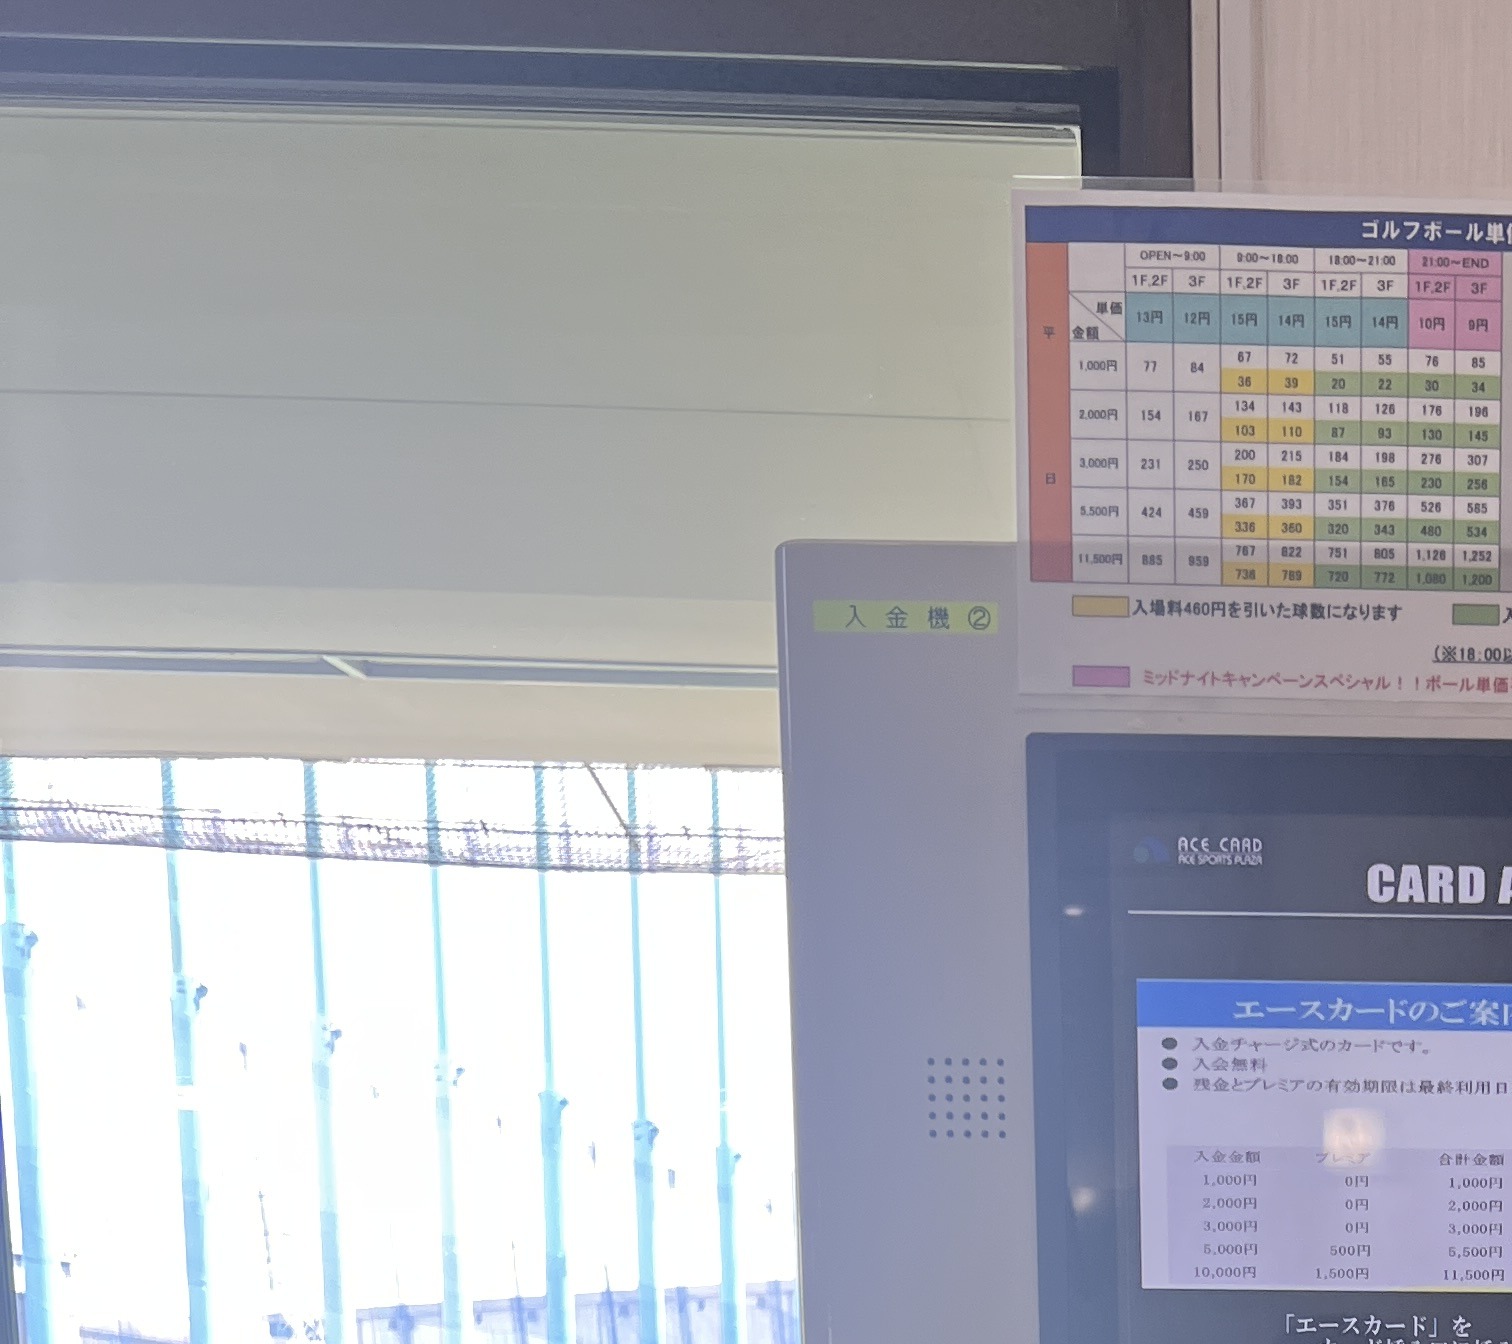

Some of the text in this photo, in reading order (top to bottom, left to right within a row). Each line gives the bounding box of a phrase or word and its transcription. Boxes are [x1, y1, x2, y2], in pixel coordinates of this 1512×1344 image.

[1189, 274, 1205, 288] 3F
[1283, 278, 1300, 291] 3F
[1377, 280, 1393, 292] 3F
[1471, 282, 1488, 295] 3F
[1096, 301, 1123, 315] 単価
[1137, 310, 1162, 325] 13円
[1184, 311, 1210, 326] 12円
[1231, 313, 1257, 327] 15円
[1278, 313, 1304, 328] 14円
[1325, 314, 1351, 329] 15円
[1372, 315, 1398, 329] 14円
[1419, 316, 1445, 331] 10円
[1468, 318, 1488, 332] 9円
[1043, 326, 1055, 339] 平
[1072, 325, 1099, 340] 金額
[1079, 359, 1117, 373] 1,000円
[1144, 360, 1157, 372] 77
[1190, 361, 1204, 373] 84
[1079, 408, 1118, 422] 2,000円
[1141, 409, 1161, 422] 154
[1079, 457, 1118, 471] 3,000円
[1141, 459, 1161, 471] 231
[1045, 472, 1055, 485] 日
[1327, 499, 1348, 511] 351
[1141, 506, 1162, 519] 424
[1132, 599, 1402, 621] 入場料460円を引いた球数になります
[1178, 837, 1263, 852] ACE CARD
[1366, 863, 1486, 905] CARD
[1192, 1037, 1431, 1055] 入金チャージ式のカードです。
[1193, 1057, 1267, 1073] 入会無料
[1203, 1173, 1257, 1187] 1,000円
[1344, 1175, 1369, 1189] 0円
[1448, 1176, 1503, 1189] 1,000円
[1203, 1198, 1257, 1210] 2,000円
[1344, 1199, 1369, 1212] 0円
[1448, 1199, 1503, 1213] 2,000円
[1203, 1220, 1258, 1233] 3,000円
[1344, 1222, 1369, 1235] 0円
[1448, 1222, 1503, 1236] 3,000円
[1203, 1243, 1258, 1256] 5,000円
[1330, 1244, 1371, 1258] 500円
[1448, 1245, 1503, 1259] 5,500円
[1194, 1266, 1256, 1279] 10,000円
[1316, 1267, 1369, 1281] 1,500円
[1443, 1268, 1505, 1282] 11,500円
[1284, 1313, 1472, 1336] 「エースカード」を
